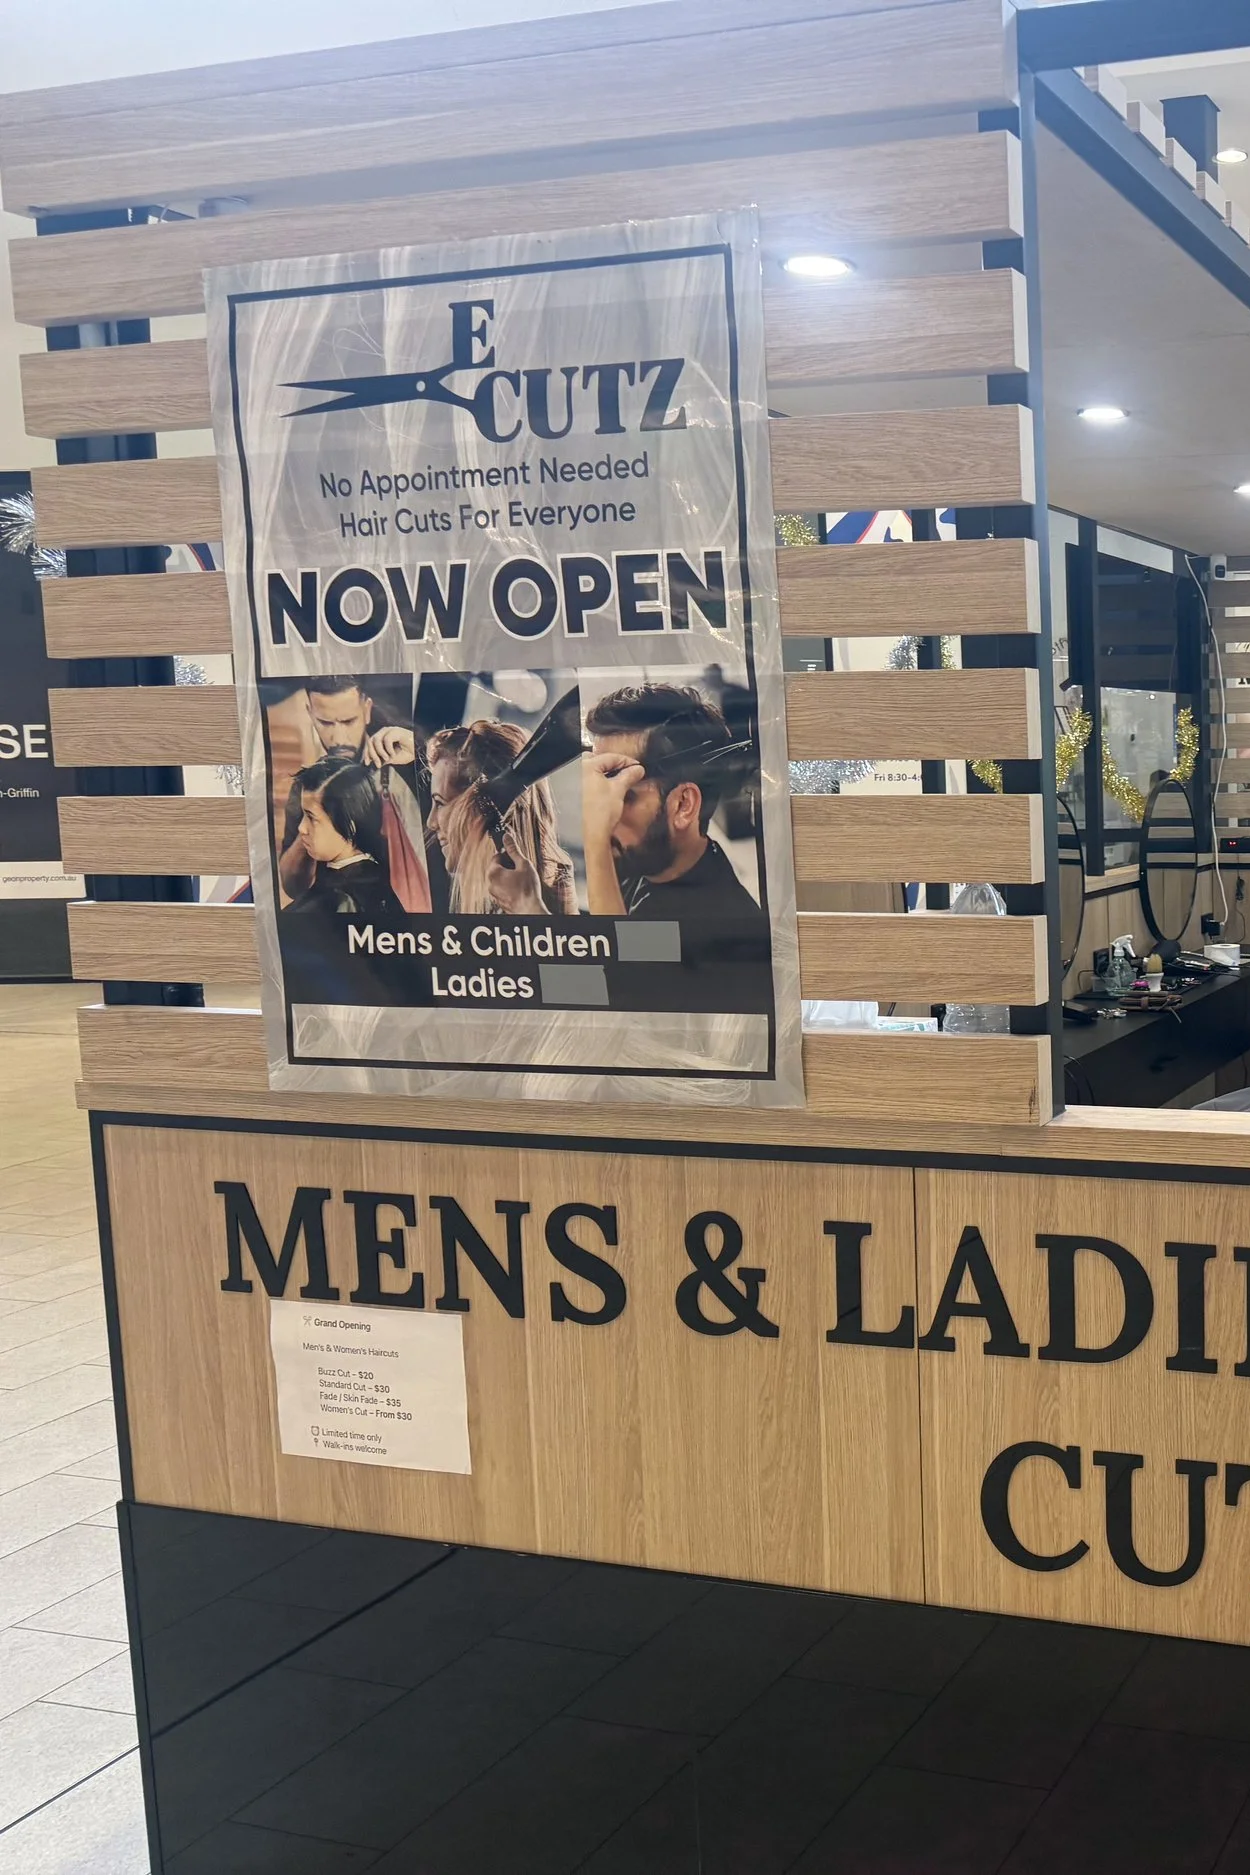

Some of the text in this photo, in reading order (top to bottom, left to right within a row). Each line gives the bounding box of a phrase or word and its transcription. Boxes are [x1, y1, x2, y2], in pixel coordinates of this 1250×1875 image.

[449, 299, 495, 369] E
[474, 358, 687, 443] CUTZ
[319, 451, 649, 500] No Appointment Needed
[341, 500, 636, 538] Hair Cuts For Everyone
[265, 546, 733, 648] NOW OPEN
[0, 724, 49, 760] SE
[874, 773, 886, 782] Fri
[347, 924, 611, 957] Mens & Children
[431, 966, 534, 998] Ladies
[214, 1180, 627, 1326] MENS
[675, 1210, 780, 1338] &
[314, 1318, 371, 1332] Grand Opening
[303, 1342, 399, 1358] Men's & Women's Haircuts
[318, 1367, 336, 1376] Buzz
[337, 1369, 351, 1378] Cut
[358, 1371, 374, 1380] $20
[319, 1379, 352, 1390] Standard
[353, 1382, 366, 1391] Cut
[374, 1385, 390, 1394] $30
[319, 1391, 337, 1401] Fade
[343, 1393, 359, 1403] Skin
[360, 1395, 378, 1405] Fade
[386, 1398, 402, 1407] $35
[320, 1404, 354, 1415] Women's
[355, 1407, 368, 1416] Cut
[375, 1409, 395, 1419] From
[396, 1412, 412, 1421] $30
[321, 1428, 382, 1443] Limited time only
[323, 1440, 387, 1455] Walk-ins welcome
